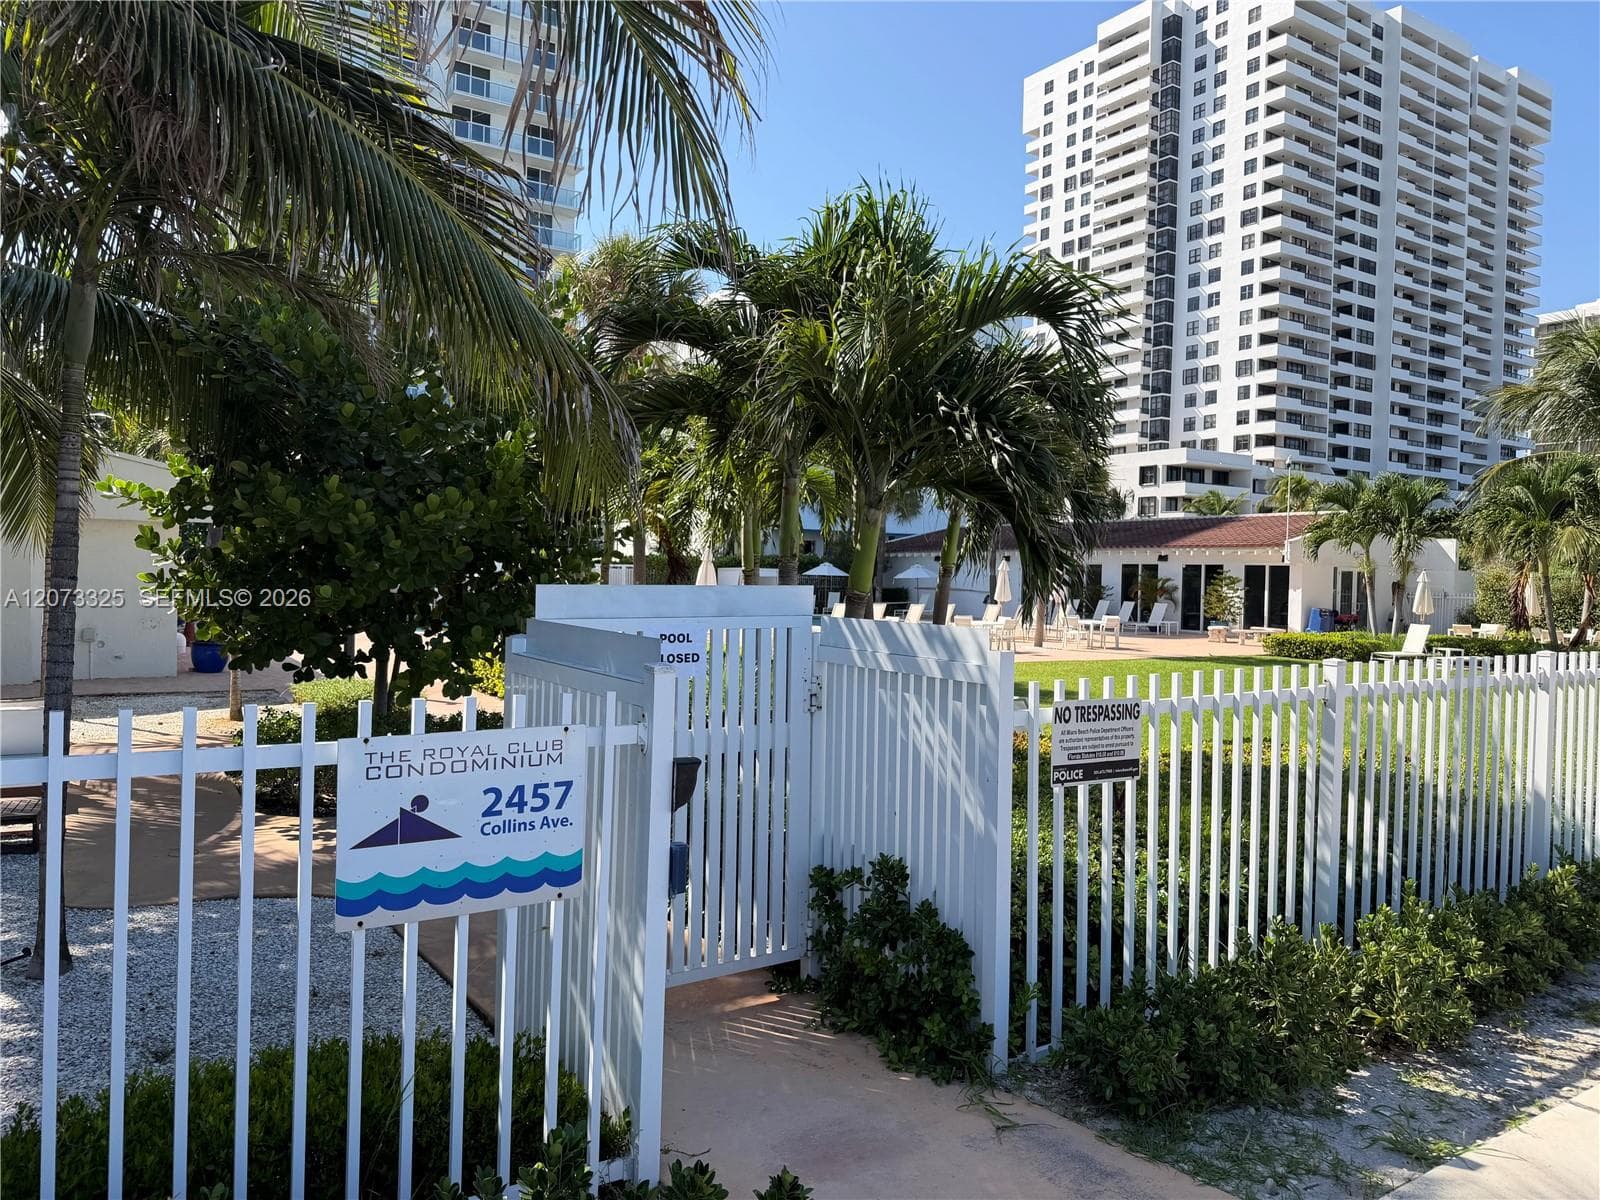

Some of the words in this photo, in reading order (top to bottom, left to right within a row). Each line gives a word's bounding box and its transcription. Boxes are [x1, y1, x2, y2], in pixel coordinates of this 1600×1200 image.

[660, 633, 693, 644] POOL
[660, 653, 700, 664] LOSED
[1054, 706, 1071, 724] NO
[1075, 703, 1141, 723] TRESPASSING
[364, 749, 411, 765] THE
[423, 744, 498, 761] ROYAL
[508, 739, 563, 754] CLUB
[365, 752, 563, 780] CONDOMINIUM
[1053, 769, 1084, 781] POLICE
[481, 780, 574, 818] 2457
[480, 819, 536, 837] Collins
[539, 815, 573, 830] Ave.
